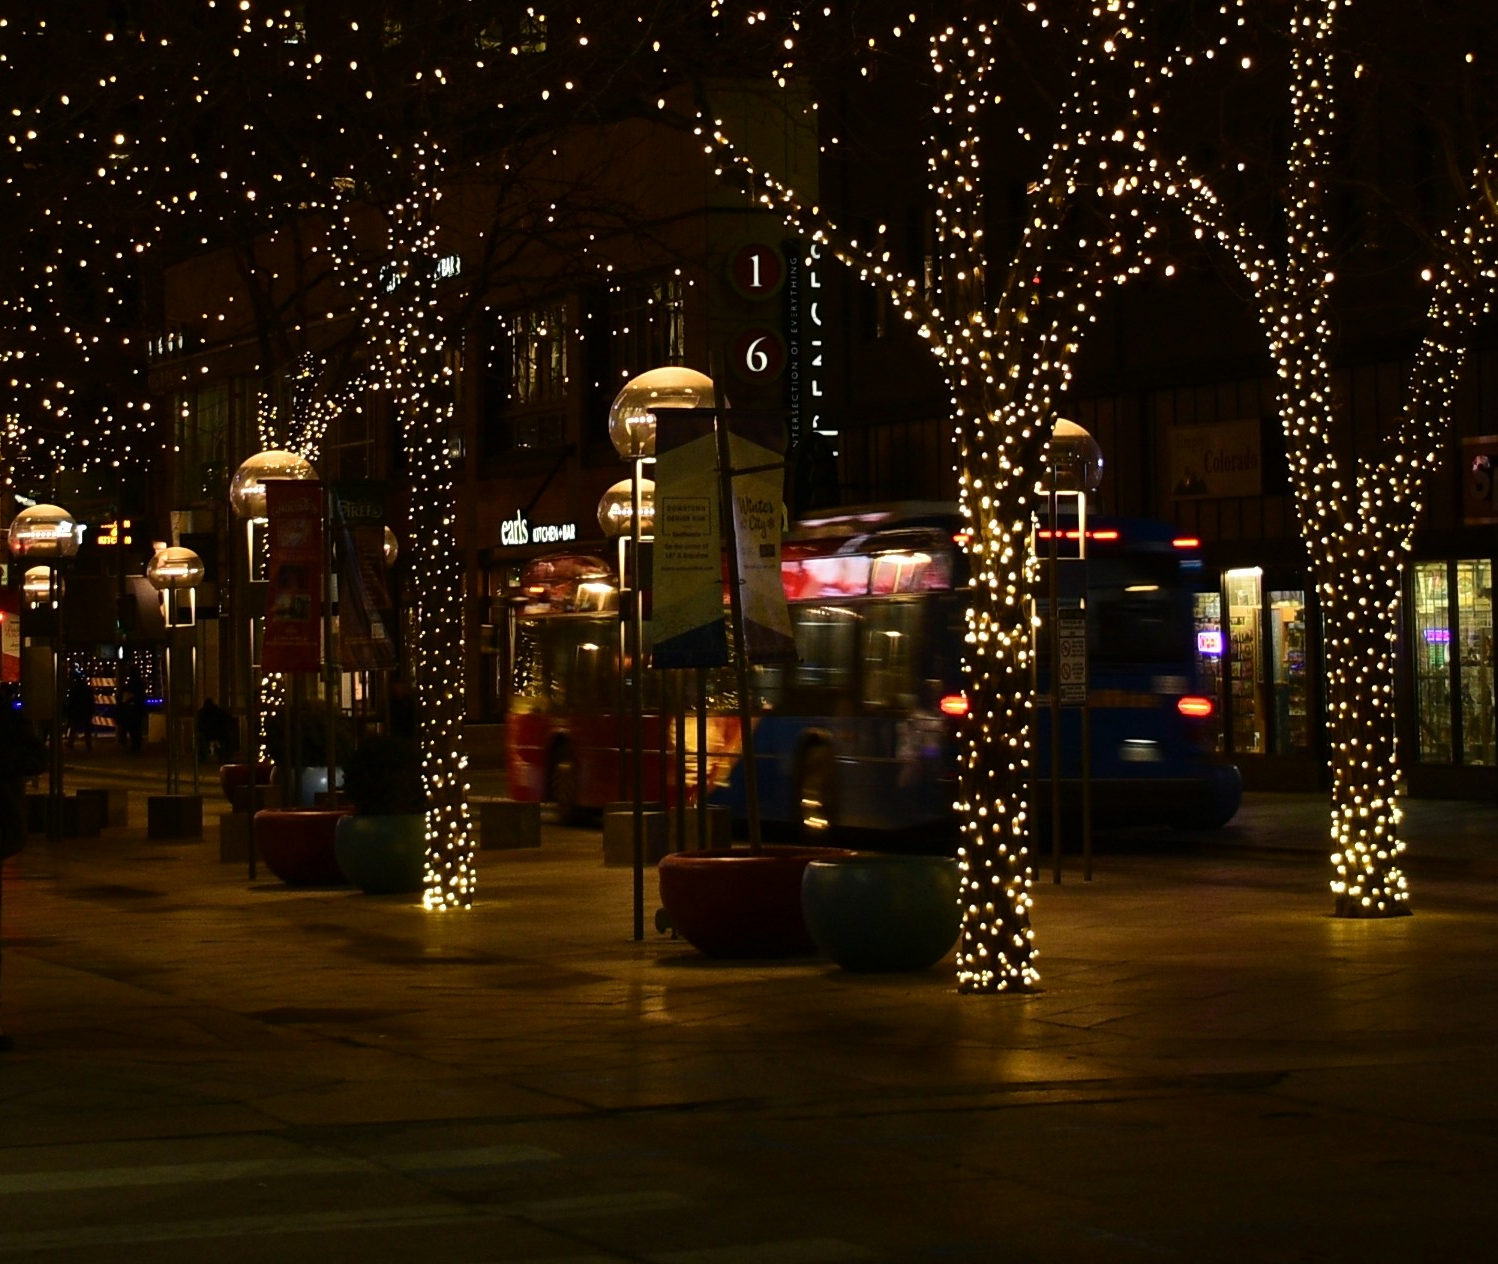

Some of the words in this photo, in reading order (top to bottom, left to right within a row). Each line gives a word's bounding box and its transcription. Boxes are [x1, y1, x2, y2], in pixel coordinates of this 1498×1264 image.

[748, 253, 763, 288] 1
[745, 336, 769, 373] 6
[790, 338, 799, 356] OF
[790, 361, 800, 452] NTERSECTION
[1204, 446, 1258, 474] Colorado
[736, 496, 774, 516] Winter
[501, 509, 529, 546] earls
[562, 523, 576, 541] BAR
[748, 515, 767, 539] City
